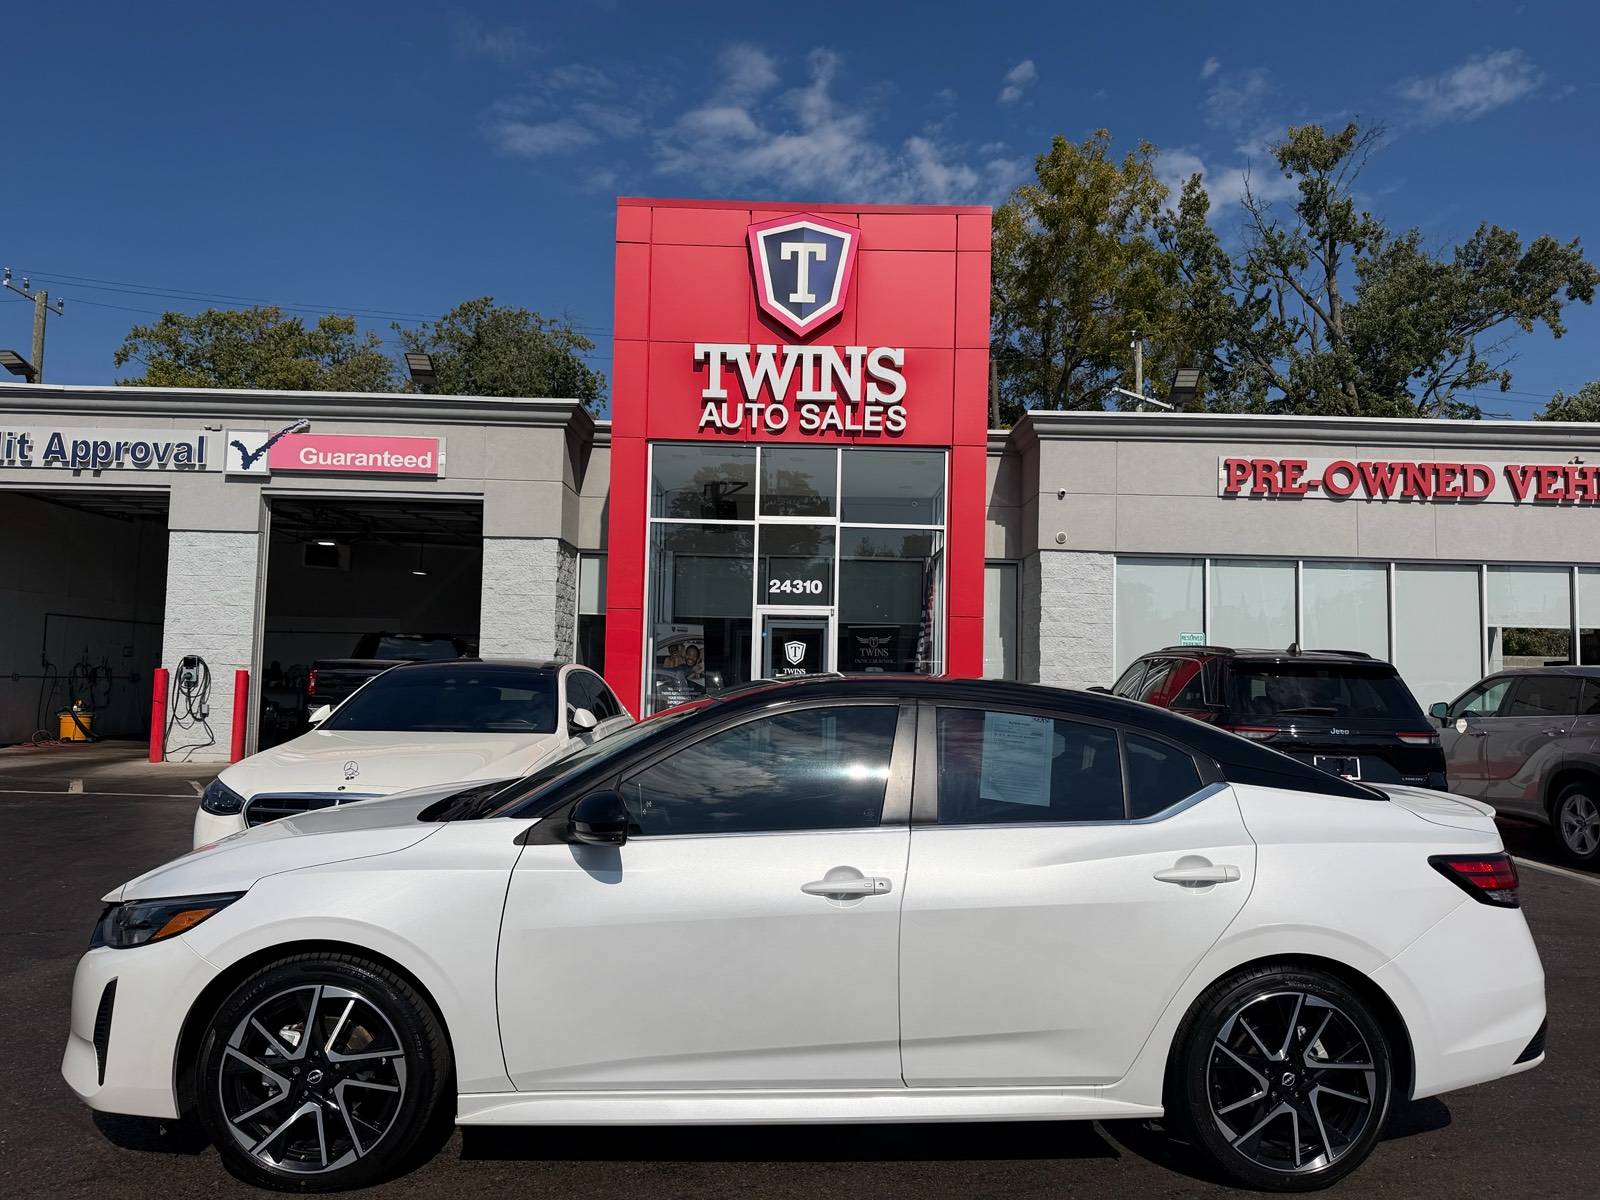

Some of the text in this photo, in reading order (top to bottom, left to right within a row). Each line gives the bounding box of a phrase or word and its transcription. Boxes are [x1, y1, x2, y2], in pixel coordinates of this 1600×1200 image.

[780, 242, 827, 303] T
[694, 343, 907, 404] TWINS
[699, 402, 907, 432] AUTO SALES
[0, 431, 205, 469] it Approval
[299, 447, 433, 470] Guaranteed
[1224, 458, 1600, 500] PRE-OWNED VEH
[769, 579, 823, 594] 24310
[859, 647, 889, 657] TWINS
